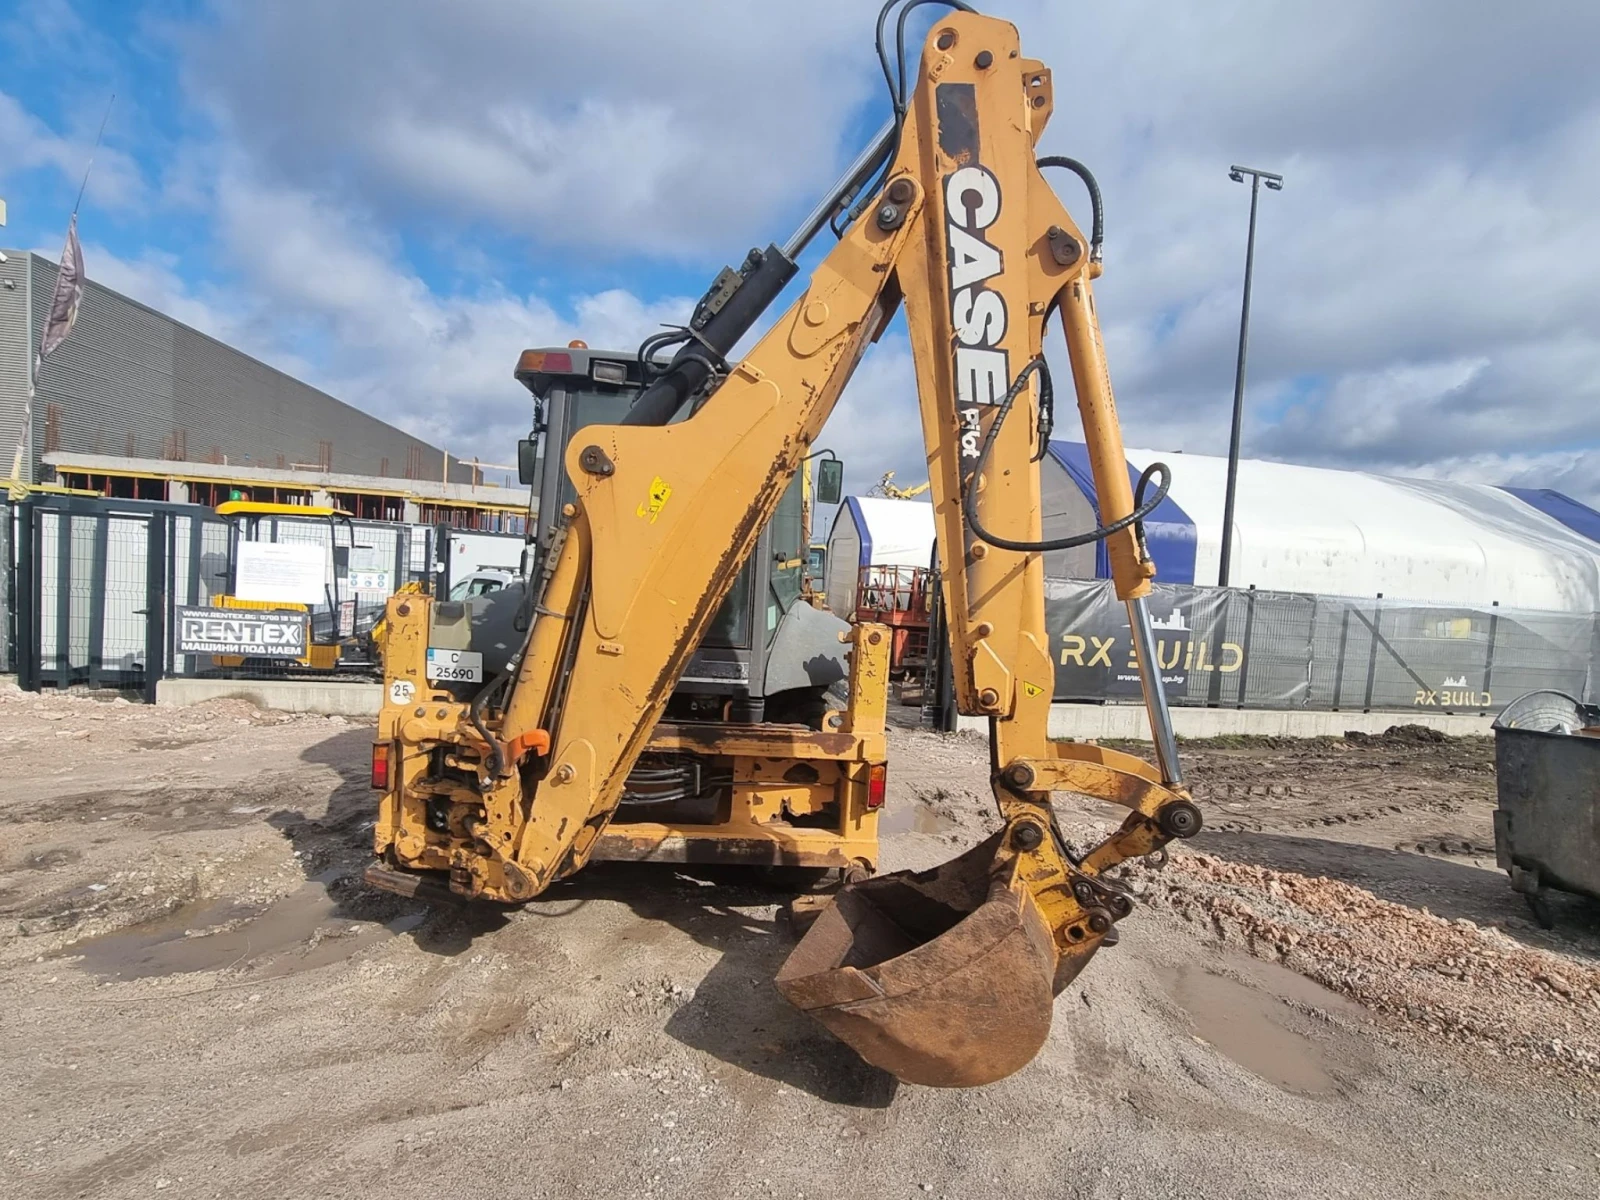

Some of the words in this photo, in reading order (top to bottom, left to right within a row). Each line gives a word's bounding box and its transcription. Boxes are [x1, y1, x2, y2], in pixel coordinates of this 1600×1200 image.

[946, 167, 1007, 406] CASE
[185, 619, 301, 646] RENTEX
[181, 642, 239, 653] МАШИНИ
[240, 645, 266, 654] ПОД
[267, 646, 301, 655] НАЕМ
[1060, 635, 1115, 667] RX
[451, 653, 459, 663] C
[436, 667, 473, 680] 25690
[394, 684, 409, 696] 25
[1414, 690, 1437, 706] RX
[1441, 691, 1492, 707] BUILD
